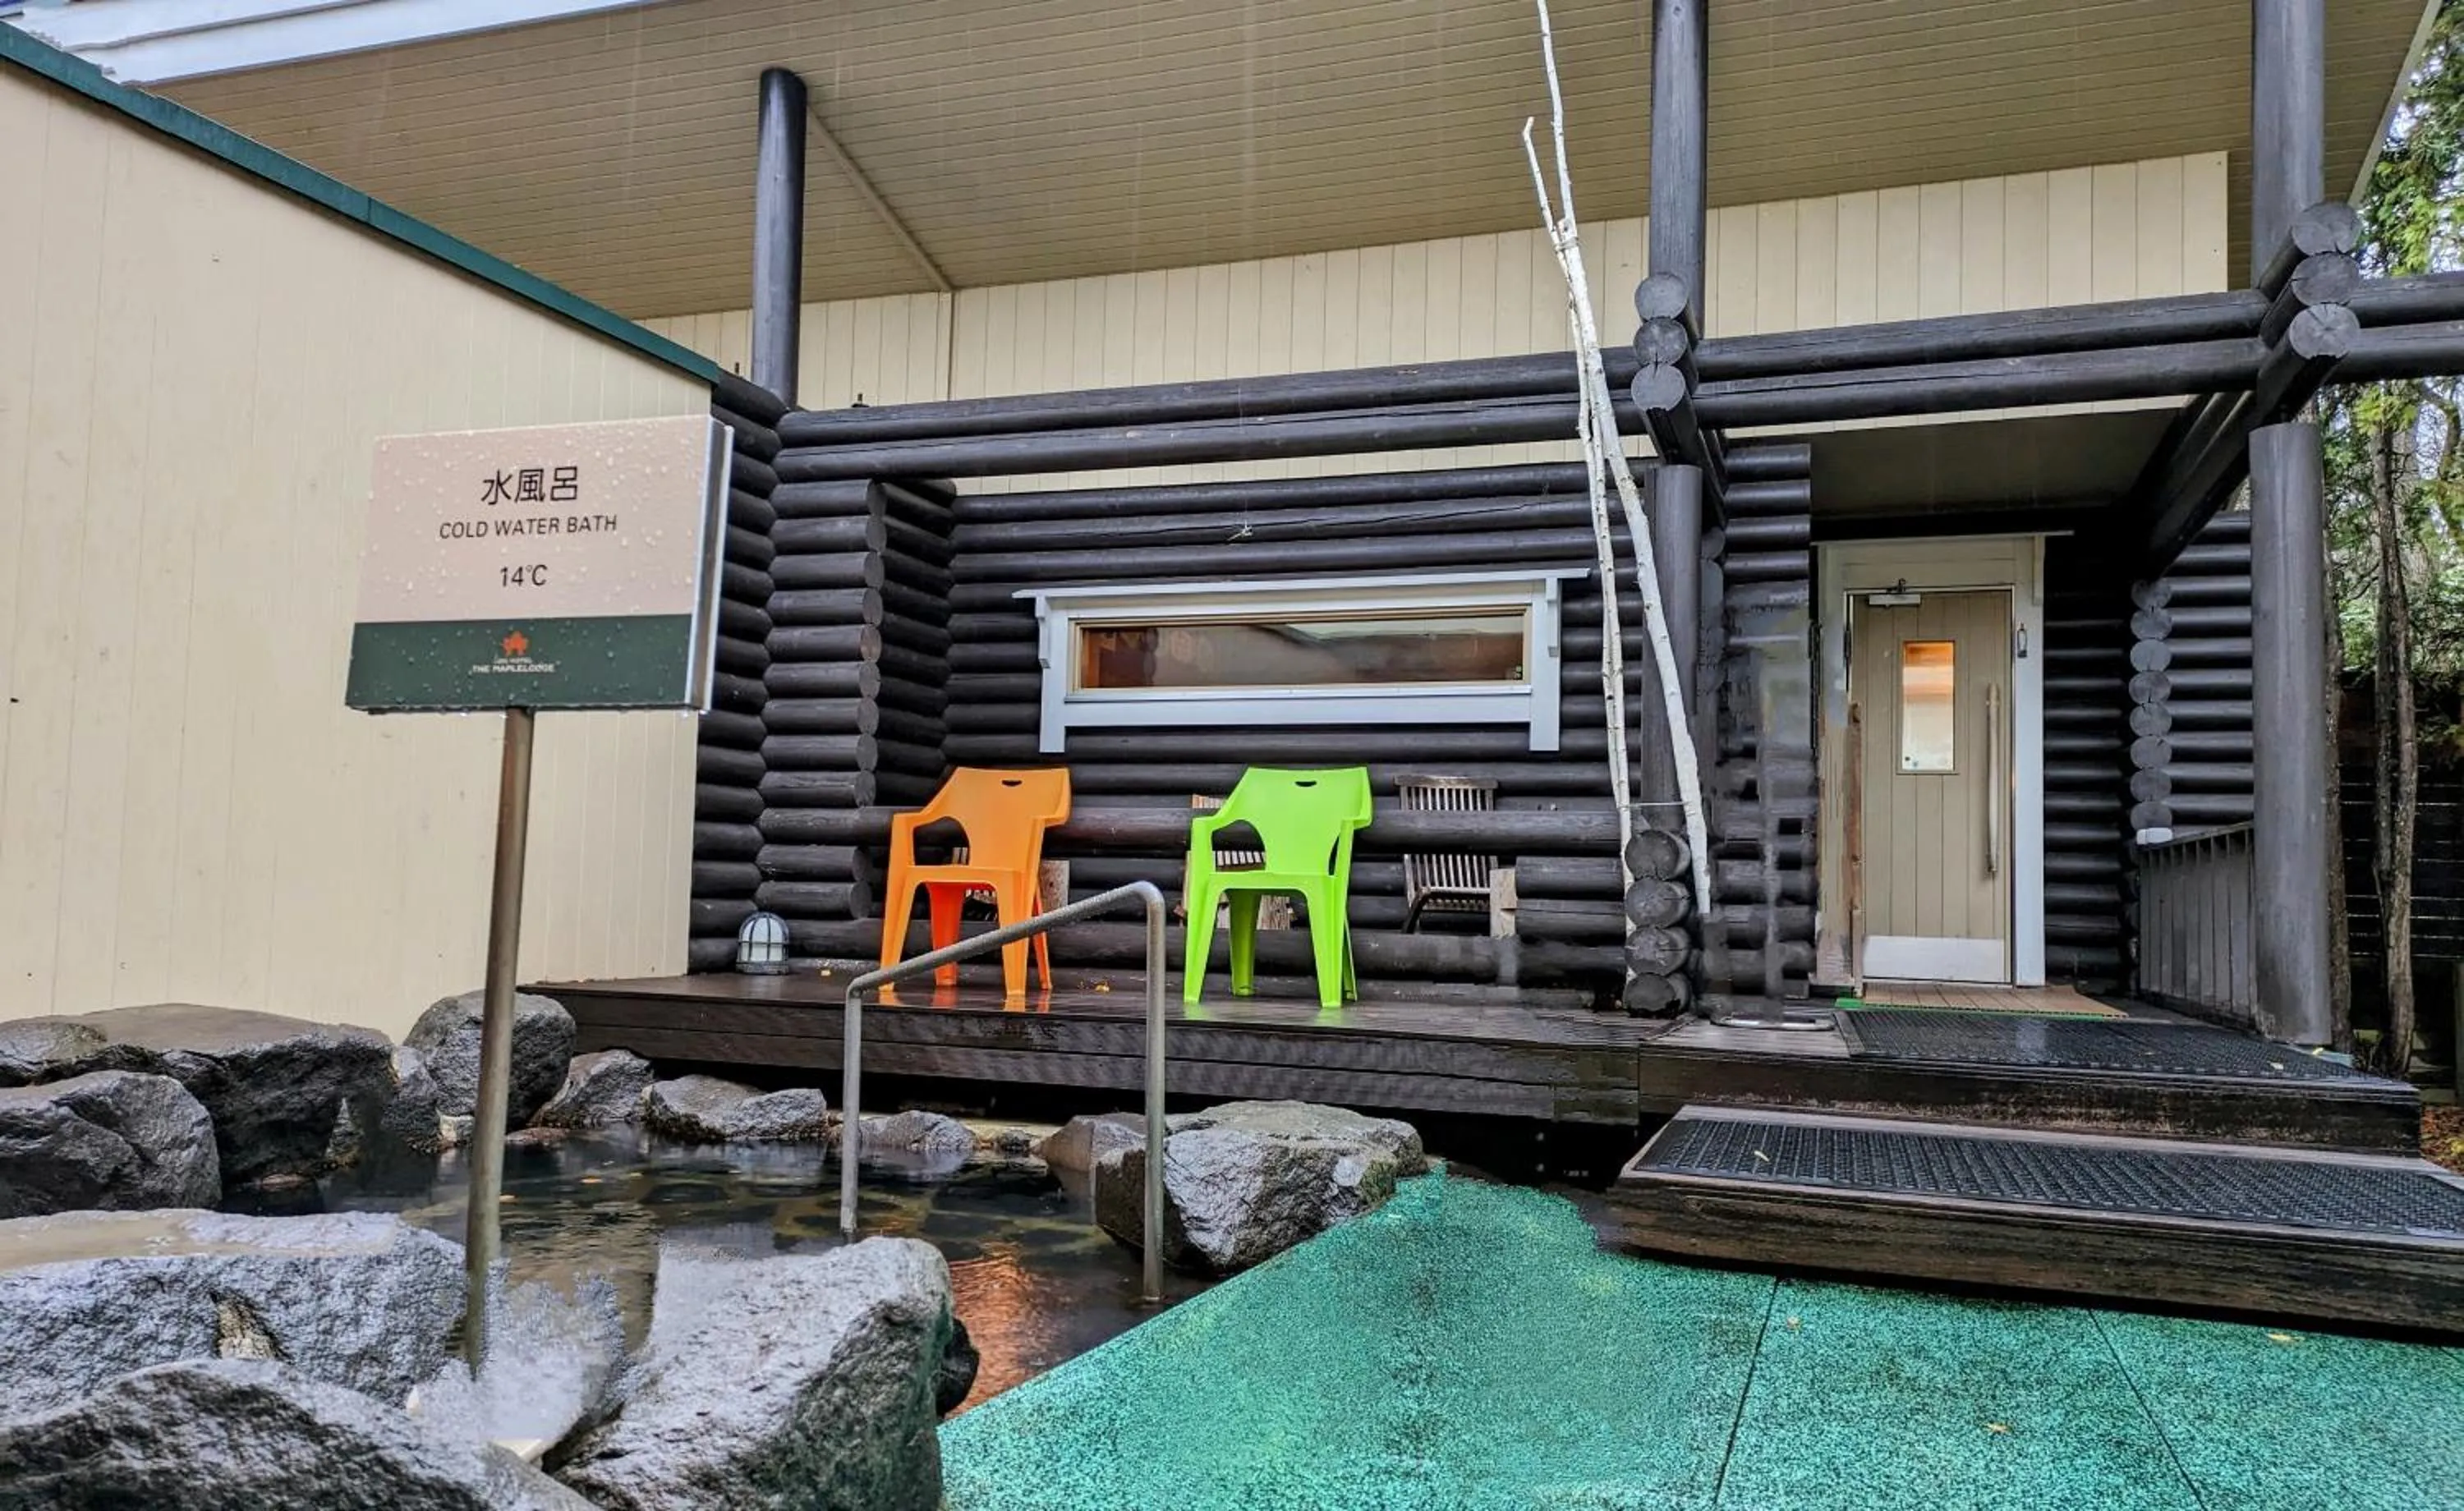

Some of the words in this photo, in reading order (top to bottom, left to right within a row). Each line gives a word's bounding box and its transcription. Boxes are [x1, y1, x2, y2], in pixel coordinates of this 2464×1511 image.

[481, 466, 578, 505] 水風呂
[439, 520, 488, 540] COLD
[494, 517, 560, 536] WATER
[567, 514, 617, 534] BATH
